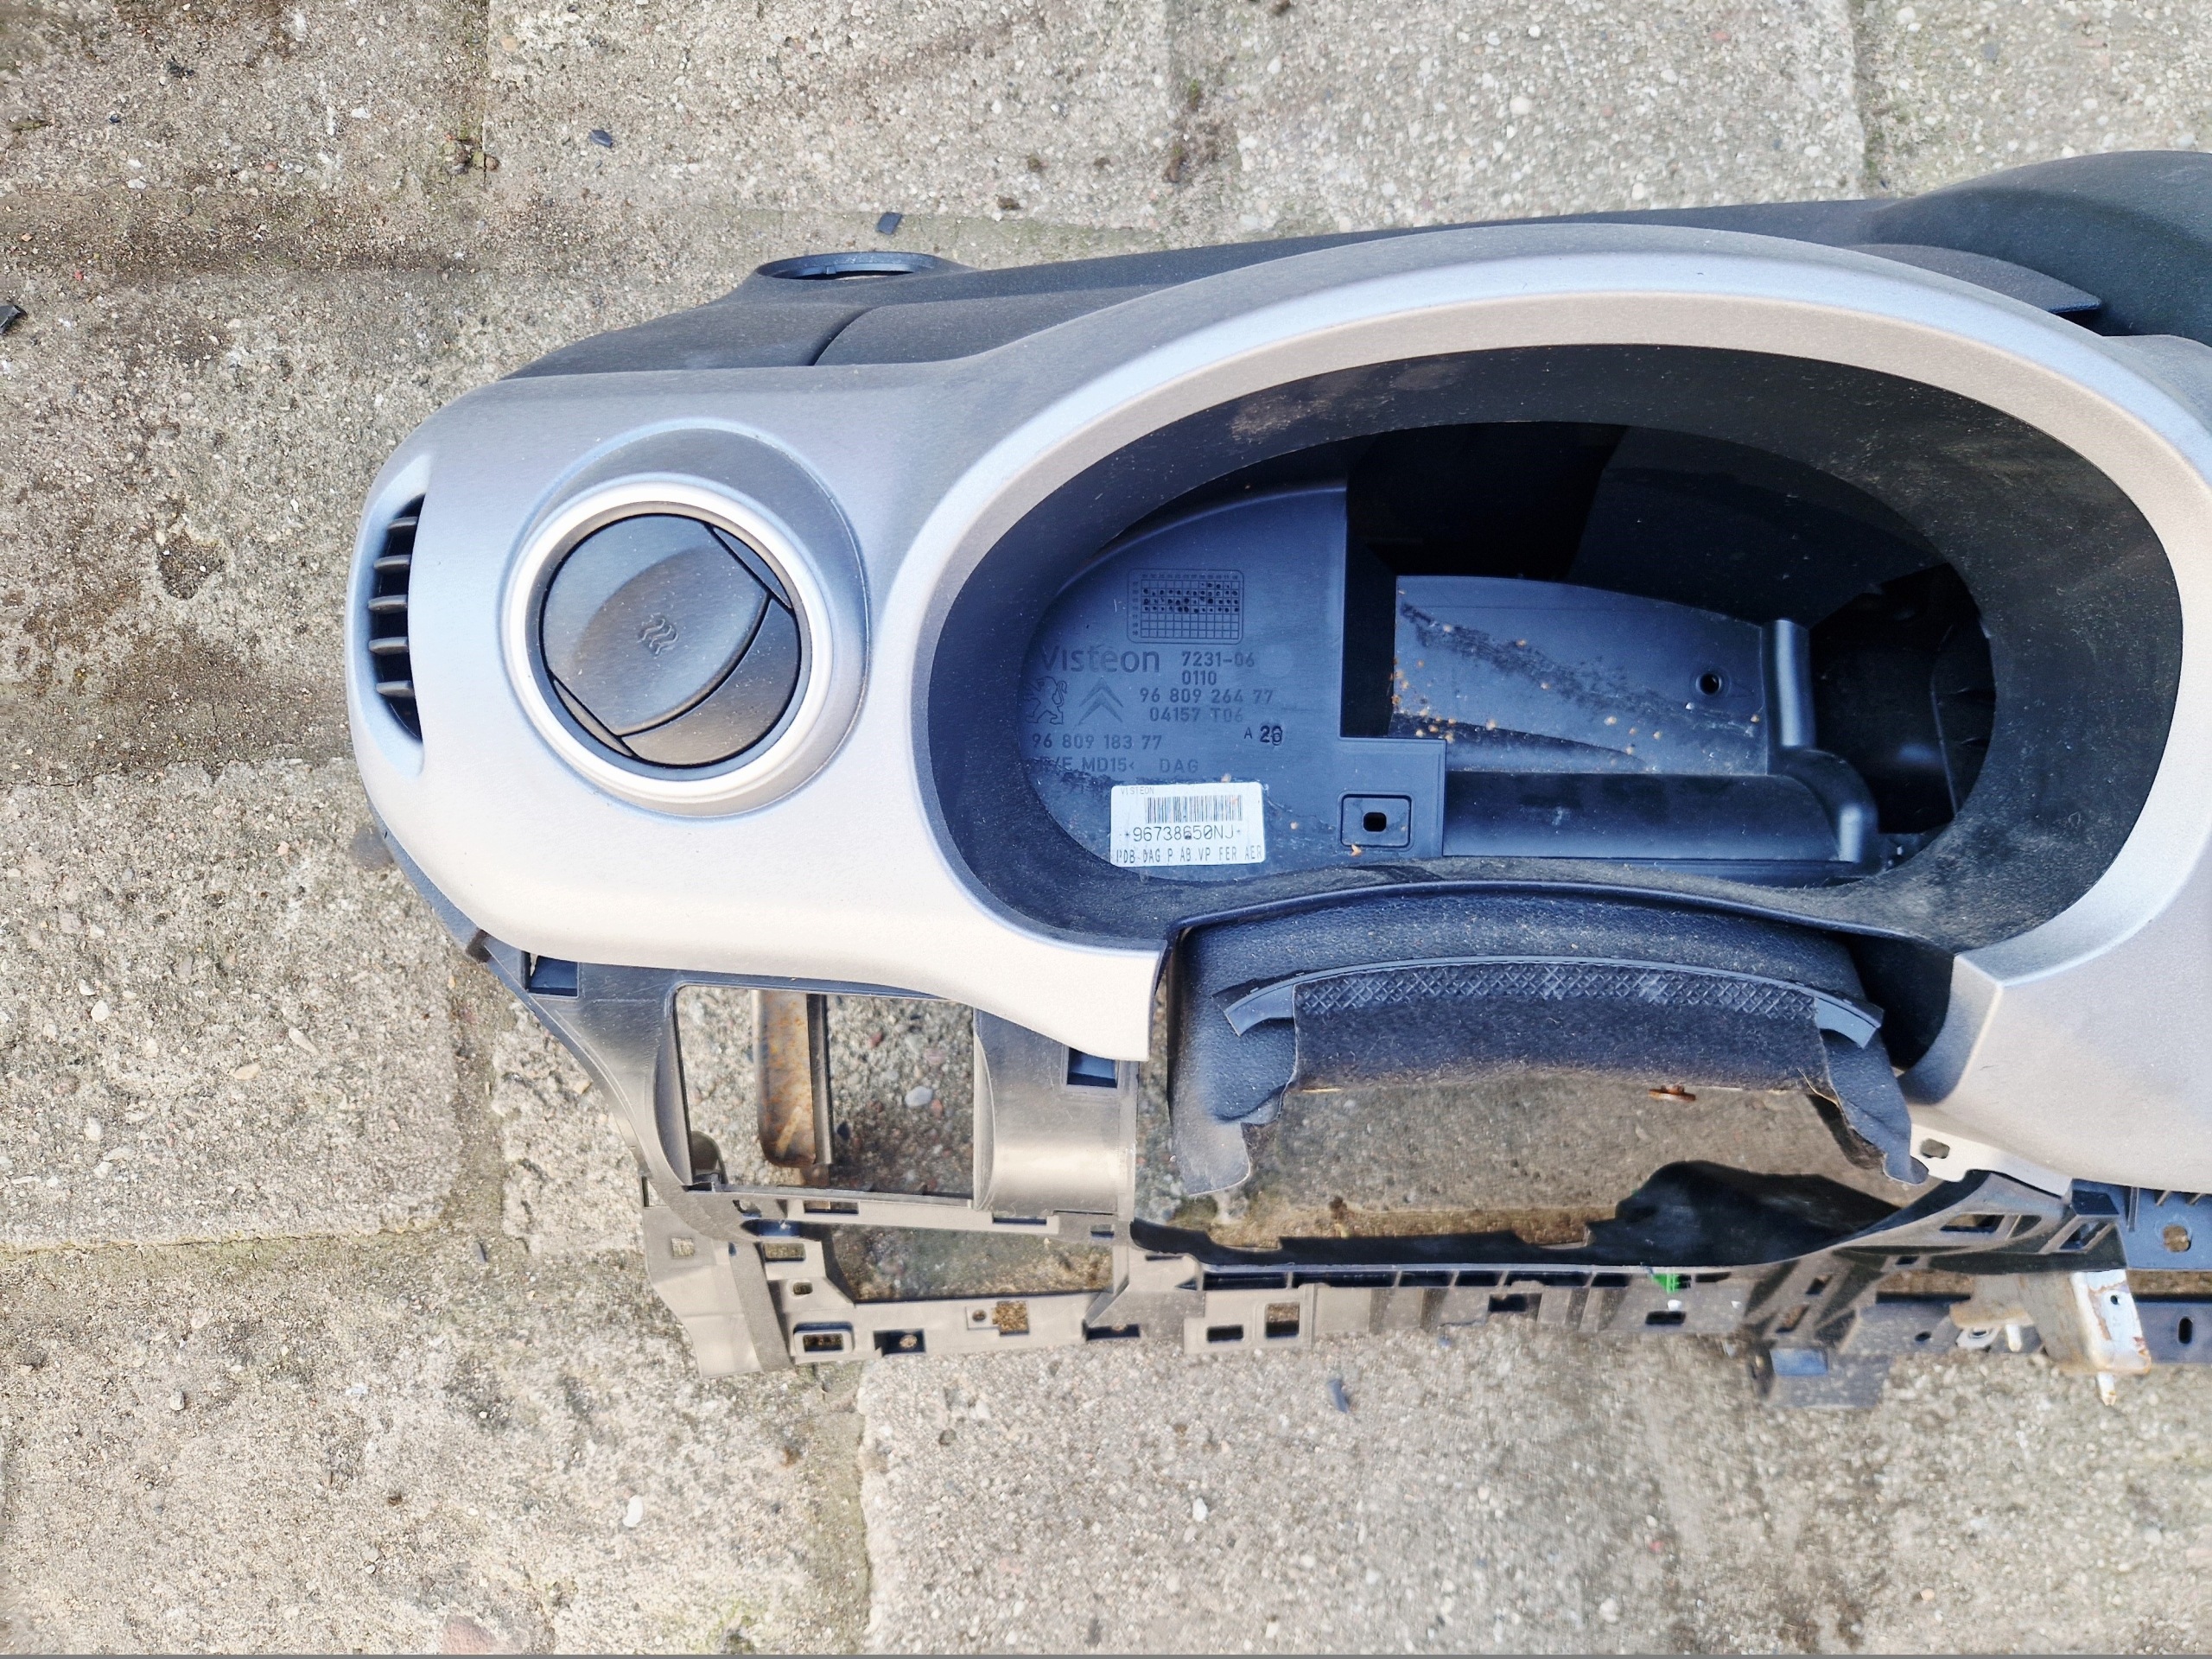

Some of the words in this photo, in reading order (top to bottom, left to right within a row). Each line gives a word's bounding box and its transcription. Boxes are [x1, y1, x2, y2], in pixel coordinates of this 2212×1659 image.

[1041, 645, 1160, 672] Visteon
[1181, 652, 1255, 667] 7231-06
[1181, 671, 1217, 685] 0110
[1140, 688, 1160, 703] 96
[1169, 689, 1202, 703] 809
[1211, 690, 1243, 704] 264
[1254, 691, 1273, 704] 77
[1149, 708, 1200, 721] 04157
[1243, 727, 1253, 740] A
[1032, 734, 1052, 748] 96
[1062, 734, 1095, 749] 809
[1103, 734, 1133, 750] 183
[1141, 735, 1162, 750] 77
[1160, 759, 1198, 773] DAG
[1120, 786, 1154, 795] VISTEON
[1142, 848, 1160, 863] DAG
[1167, 848, 1173, 862] P
[1218, 845, 1236, 861] FER
[1244, 843, 1262, 860] AER
